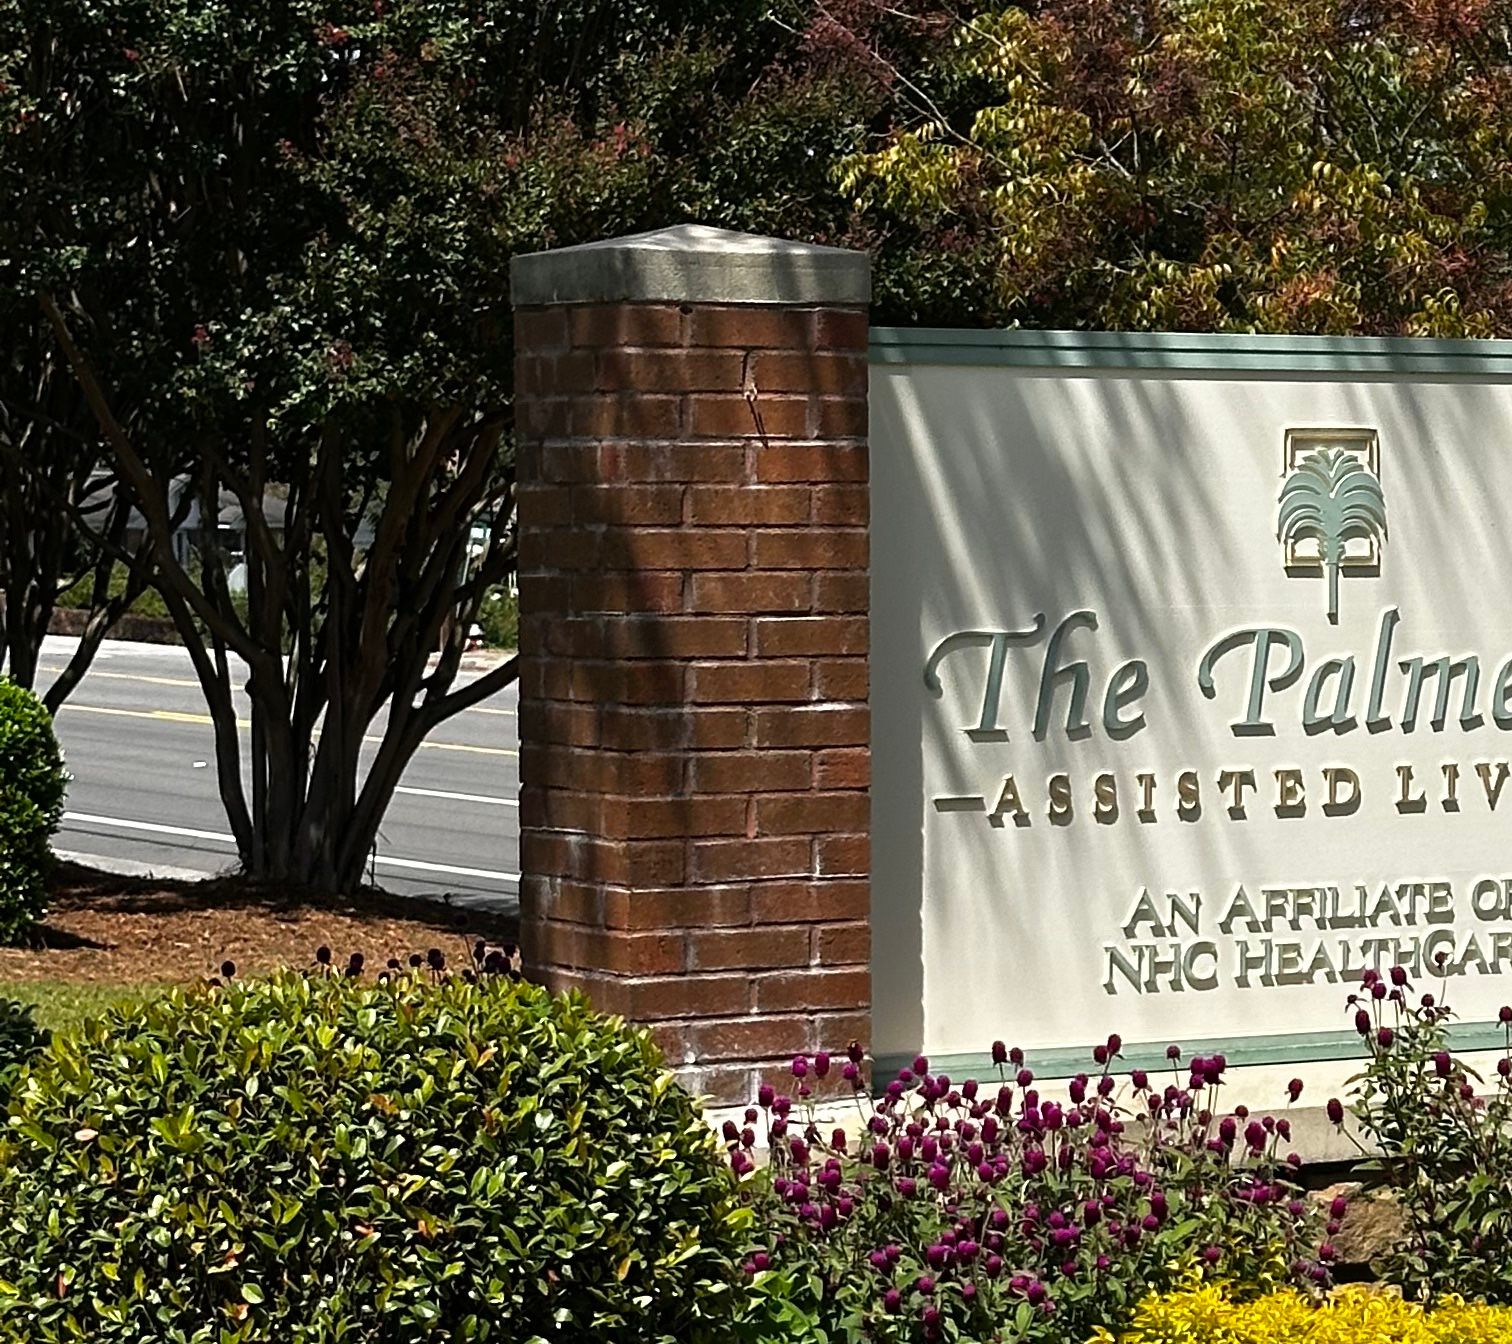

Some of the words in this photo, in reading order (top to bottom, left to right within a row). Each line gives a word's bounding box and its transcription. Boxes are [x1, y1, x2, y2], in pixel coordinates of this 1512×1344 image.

[924, 610, 1149, 742] The
[1122, 886, 1201, 939] AN
[1219, 879, 1454, 932] AFFILIATE
[1103, 943, 1218, 994] NHC
